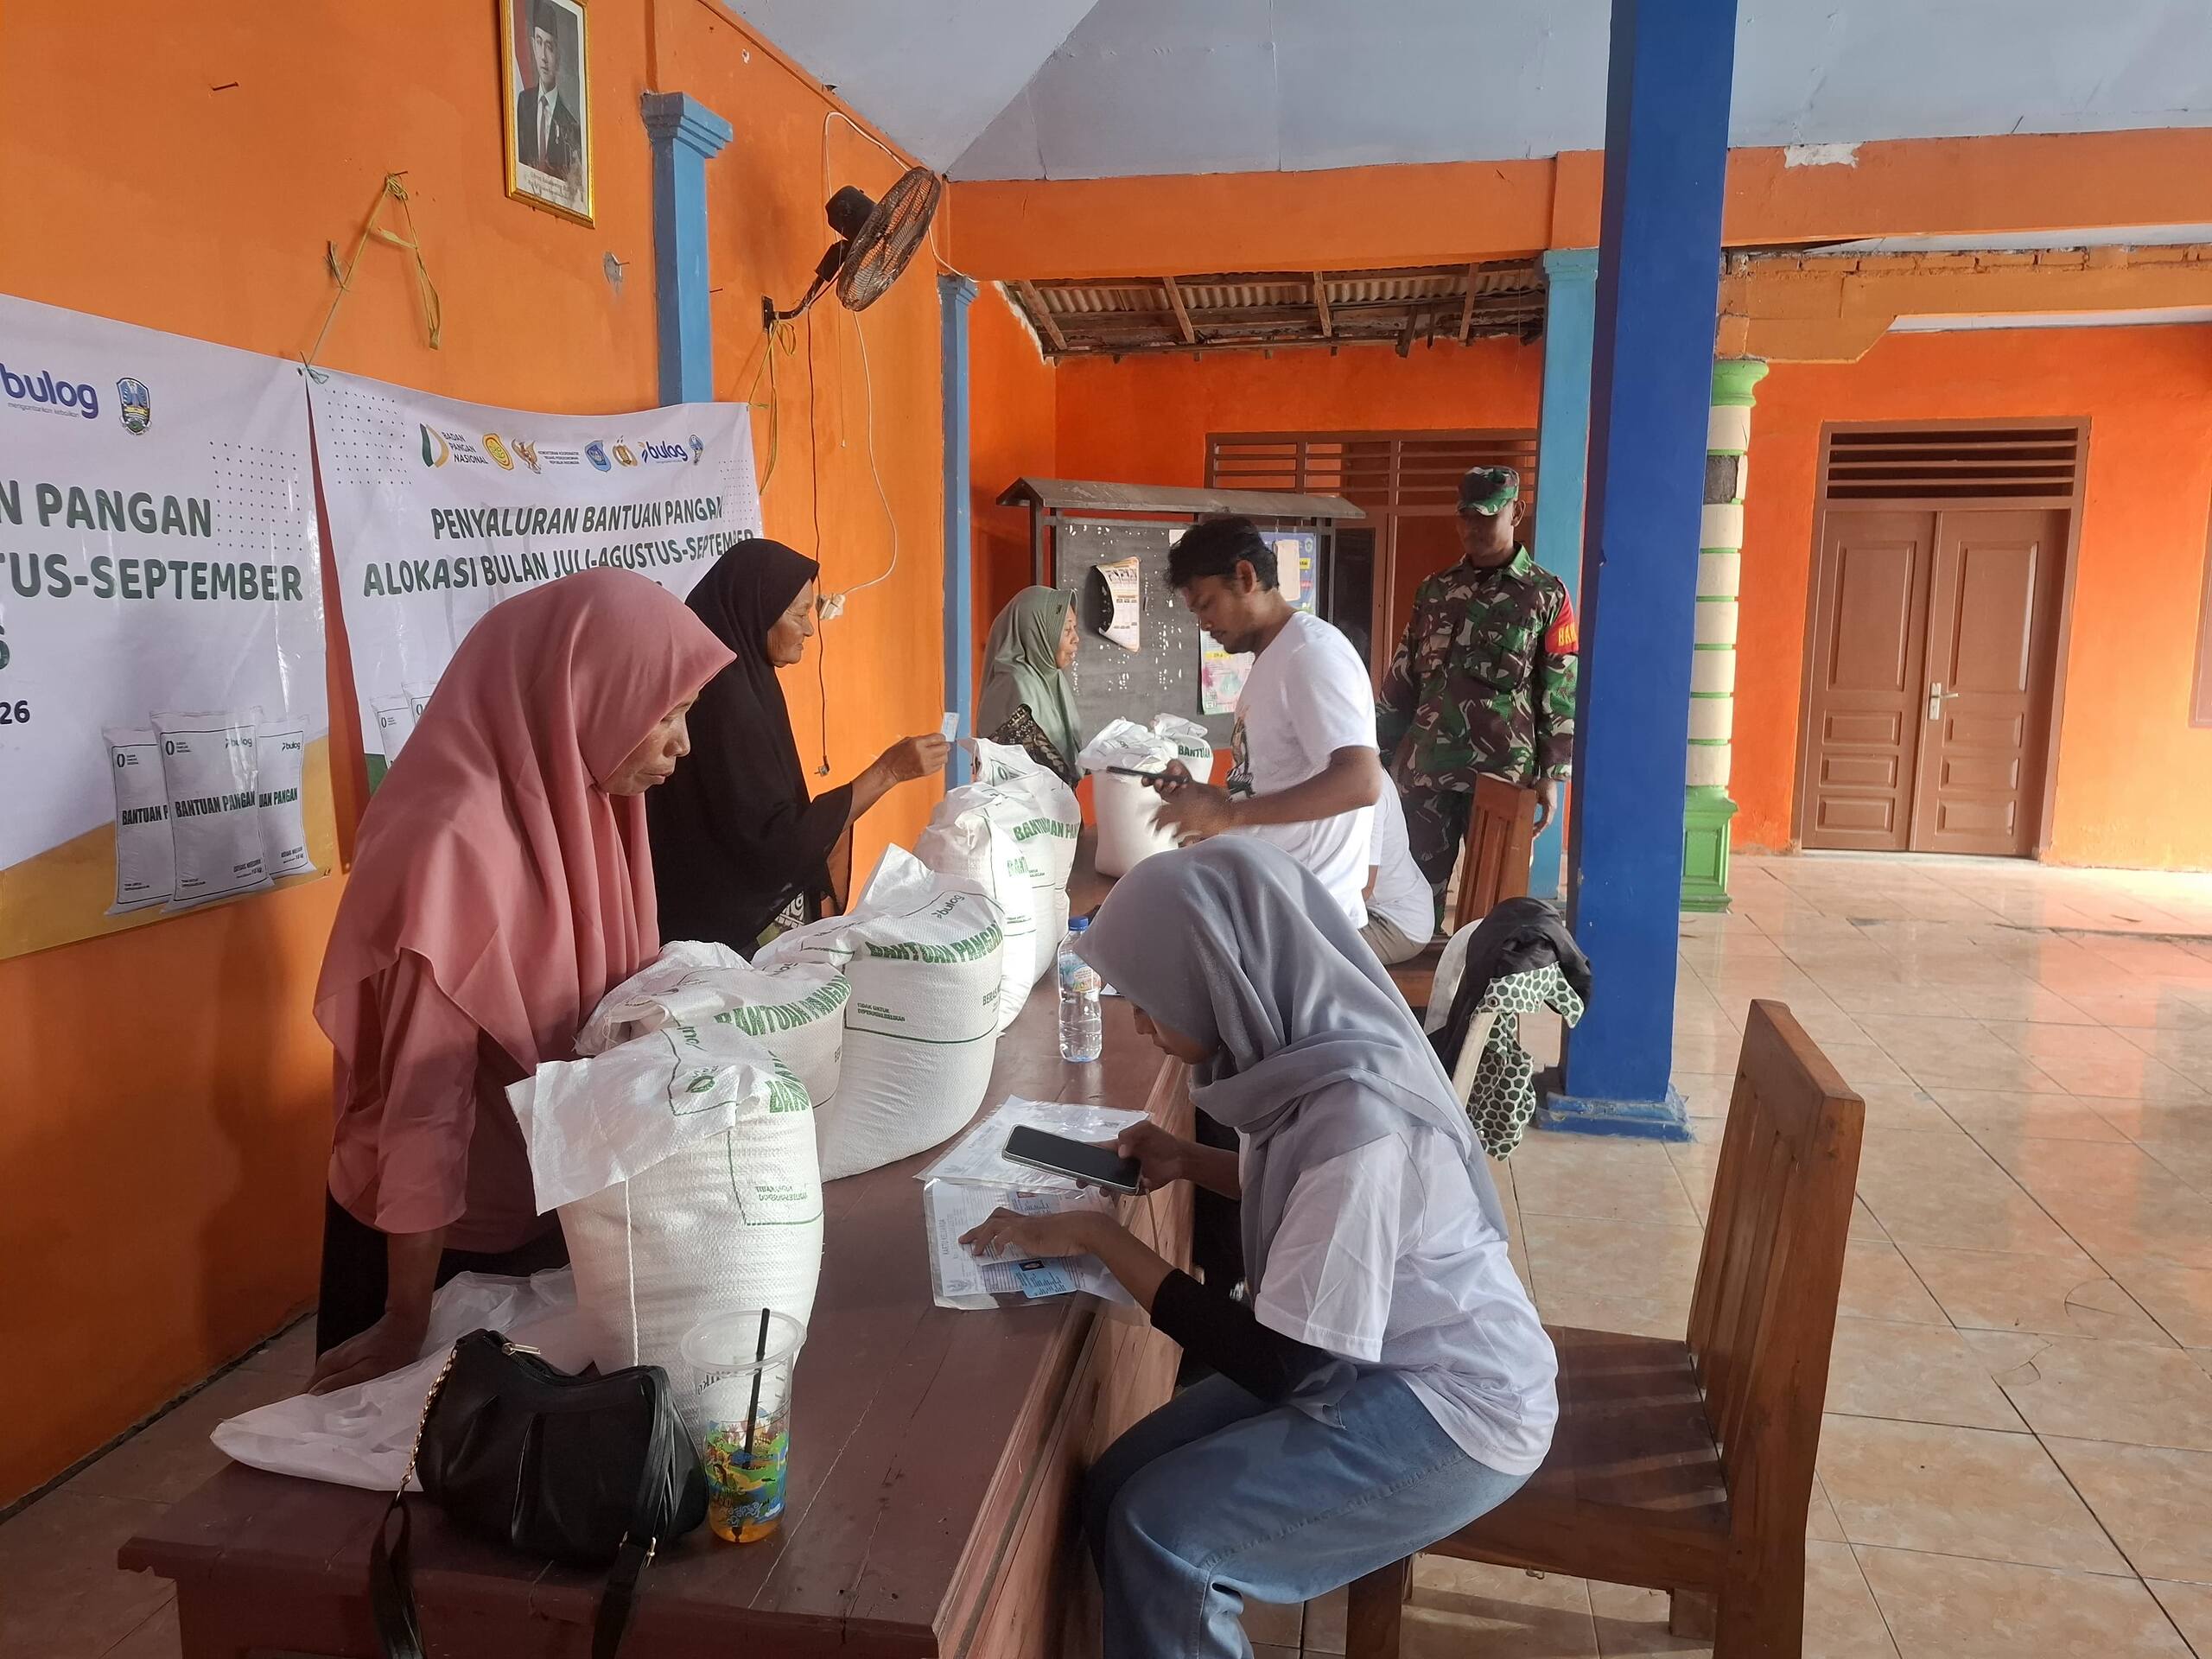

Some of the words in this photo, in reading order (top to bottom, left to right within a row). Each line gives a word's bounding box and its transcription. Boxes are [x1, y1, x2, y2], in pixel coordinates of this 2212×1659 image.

[0, 362, 99, 419] bulog
[442, 432, 466, 442] BADAN
[448, 442, 476, 453] PANGAN
[454, 454, 489, 465] NASIONAL
[645, 440, 689, 461] bulog
[35, 483, 212, 537] PANGAN
[431, 507, 578, 539] PENYALURAN
[582, 501, 661, 533] BANTUAN
[664, 495, 723, 526] PANGAN
[363, 556, 478, 597] ALOKASI
[480, 551, 550, 586] BULAN
[175, 796, 221, 818] BANTUAN
[222, 791, 256, 812] PANGAN
[274, 787, 298, 804] PANGAN
[122, 805, 162, 825] BANTUAN
[936, 894, 965, 916] bulog
